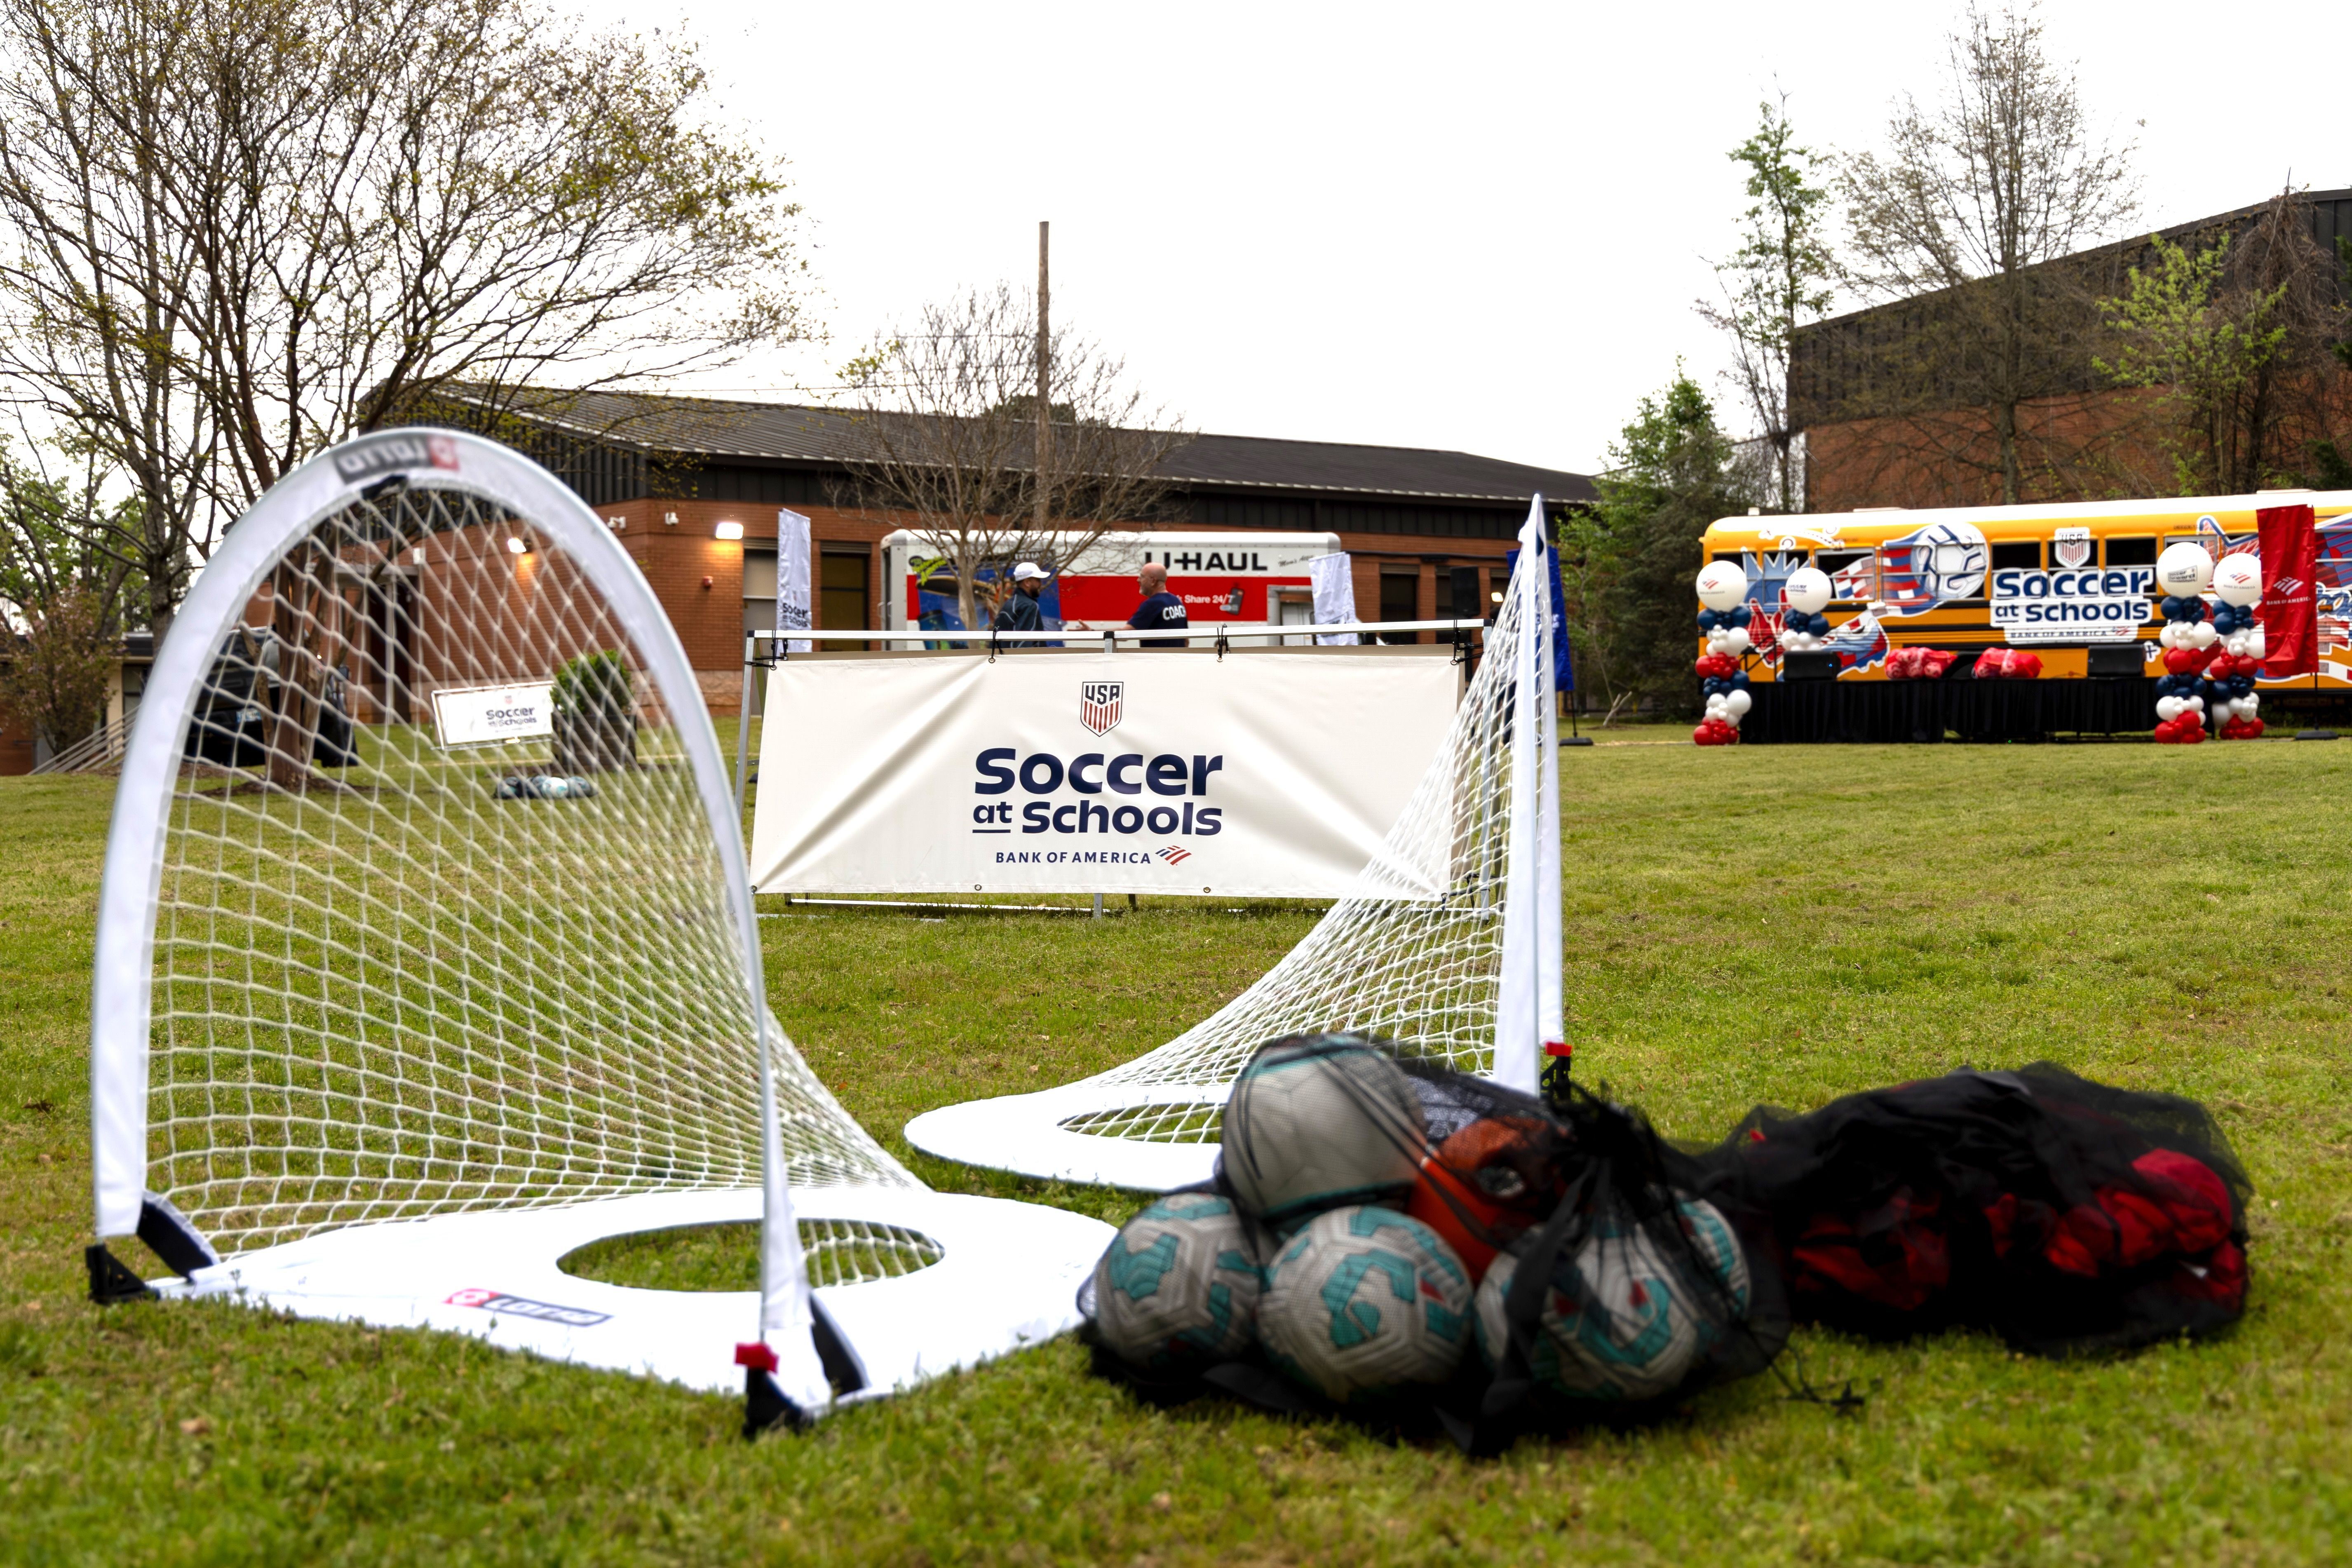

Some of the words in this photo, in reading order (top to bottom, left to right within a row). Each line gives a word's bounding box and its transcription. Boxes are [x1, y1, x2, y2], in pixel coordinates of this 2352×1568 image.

[2061, 534, 2083, 546] USA
[1145, 552, 1268, 571] U-HAUL
[1996, 571, 2149, 599] Soccer
[1184, 594, 1211, 604] Share
[1212, 593, 1236, 604] 24/7
[1163, 605, 1187, 620] COAC
[1995, 604, 2019, 617] at
[2026, 600, 2149, 622] Schools
[1085, 685, 1120, 705] USA
[486, 707, 535, 720] Soccer
[498, 717, 537, 727] Schools
[975, 747, 1223, 796] Soccer
[972, 801, 1013, 824] at
[1022, 800, 1223, 836] Schools
[995, 852, 1042, 864] BANK
[1047, 852, 1068, 863] OF
[1071, 851, 1151, 864] AMERICA
